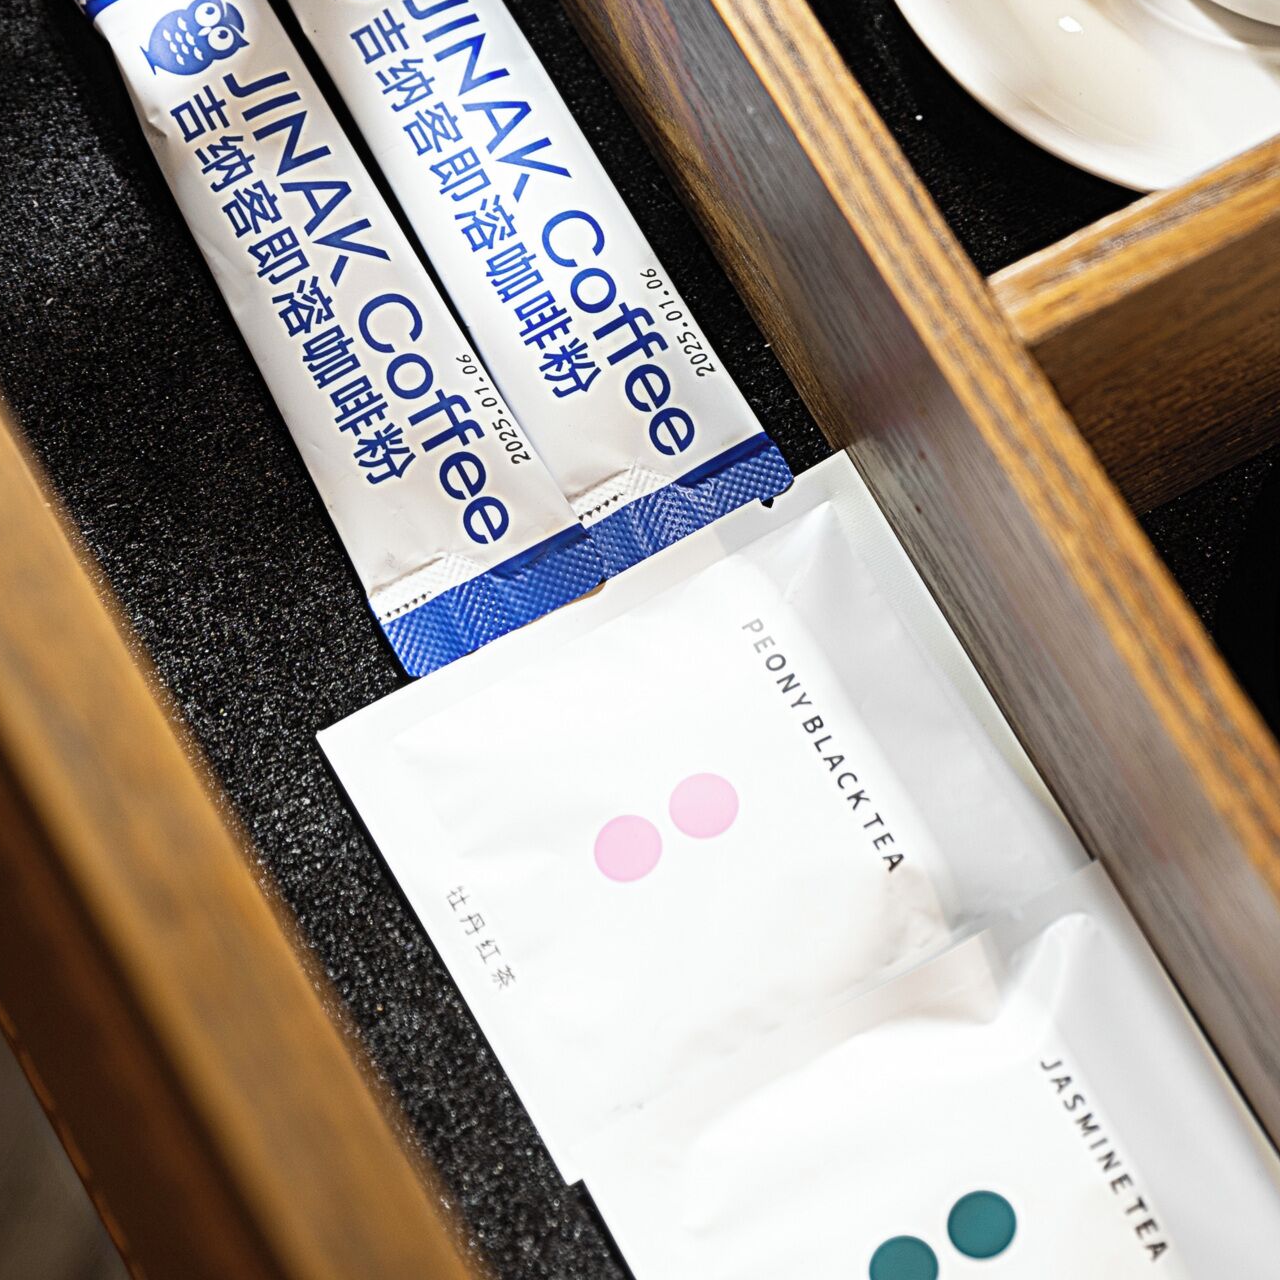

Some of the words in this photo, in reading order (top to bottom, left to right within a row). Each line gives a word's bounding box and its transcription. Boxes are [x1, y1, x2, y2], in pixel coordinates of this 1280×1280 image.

[169, 84, 420, 486] 吉纳客即溶咖啡粉
[222, 71, 391, 286] JINAK
[358, 292, 510, 546] Coffee
[349, 8, 602, 398] 吉纳客即溶咖啡粉
[640, 268, 717, 378] 2025.01.06
[455, 354, 532, 465] 2025.01.06
[541, 209, 696, 457] Coffee
[741, 616, 814, 713] PEONY
[801, 714, 871, 812] BLACK
[862, 812, 906, 874] TEA
[1040, 1058, 1134, 1196] JASMINE
[1124, 1195, 1170, 1262] TEA
